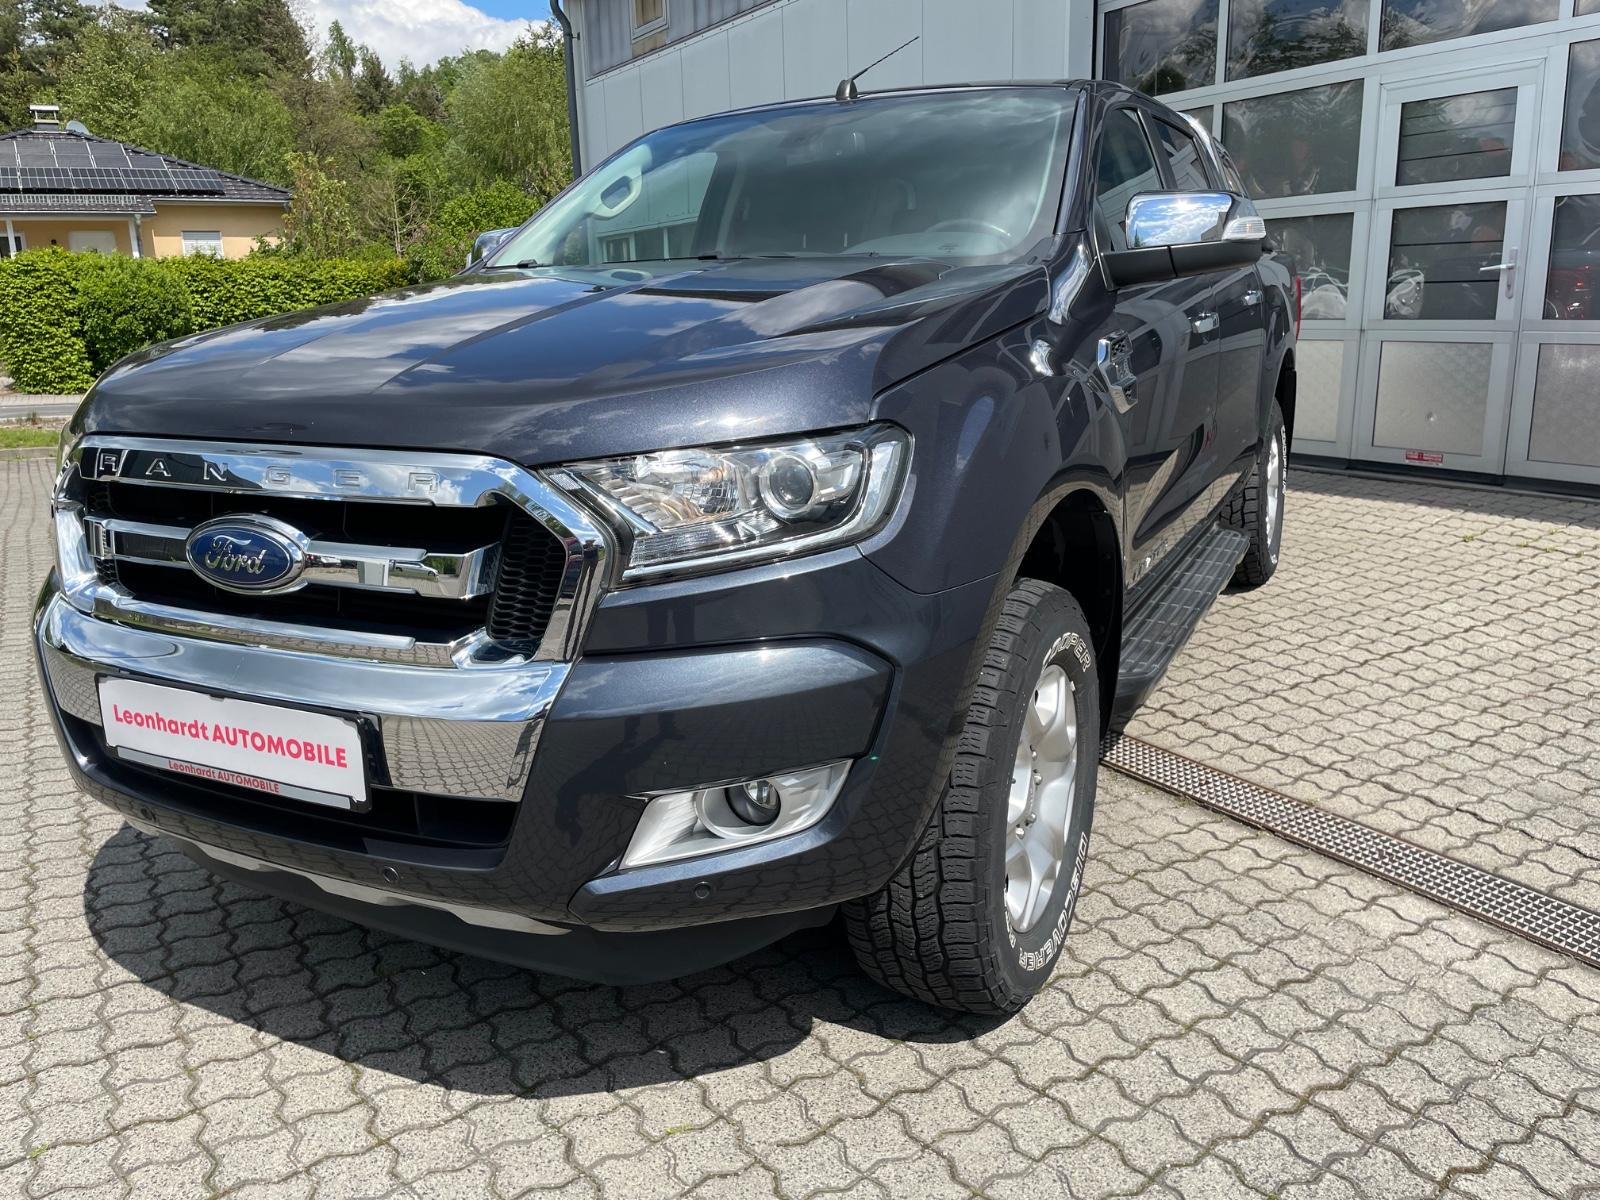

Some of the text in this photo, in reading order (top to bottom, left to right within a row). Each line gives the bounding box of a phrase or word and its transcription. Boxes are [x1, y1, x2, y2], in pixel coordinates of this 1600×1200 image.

[98, 452, 440, 494] RANGER
[204, 534, 267, 575] Ford
[113, 704, 348, 768] Leonhardt AUTOMOBILE
[168, 759, 280, 793] Leonhardt AUTOMOBILE
[1018, 831, 1089, 971] DISCOVERER
